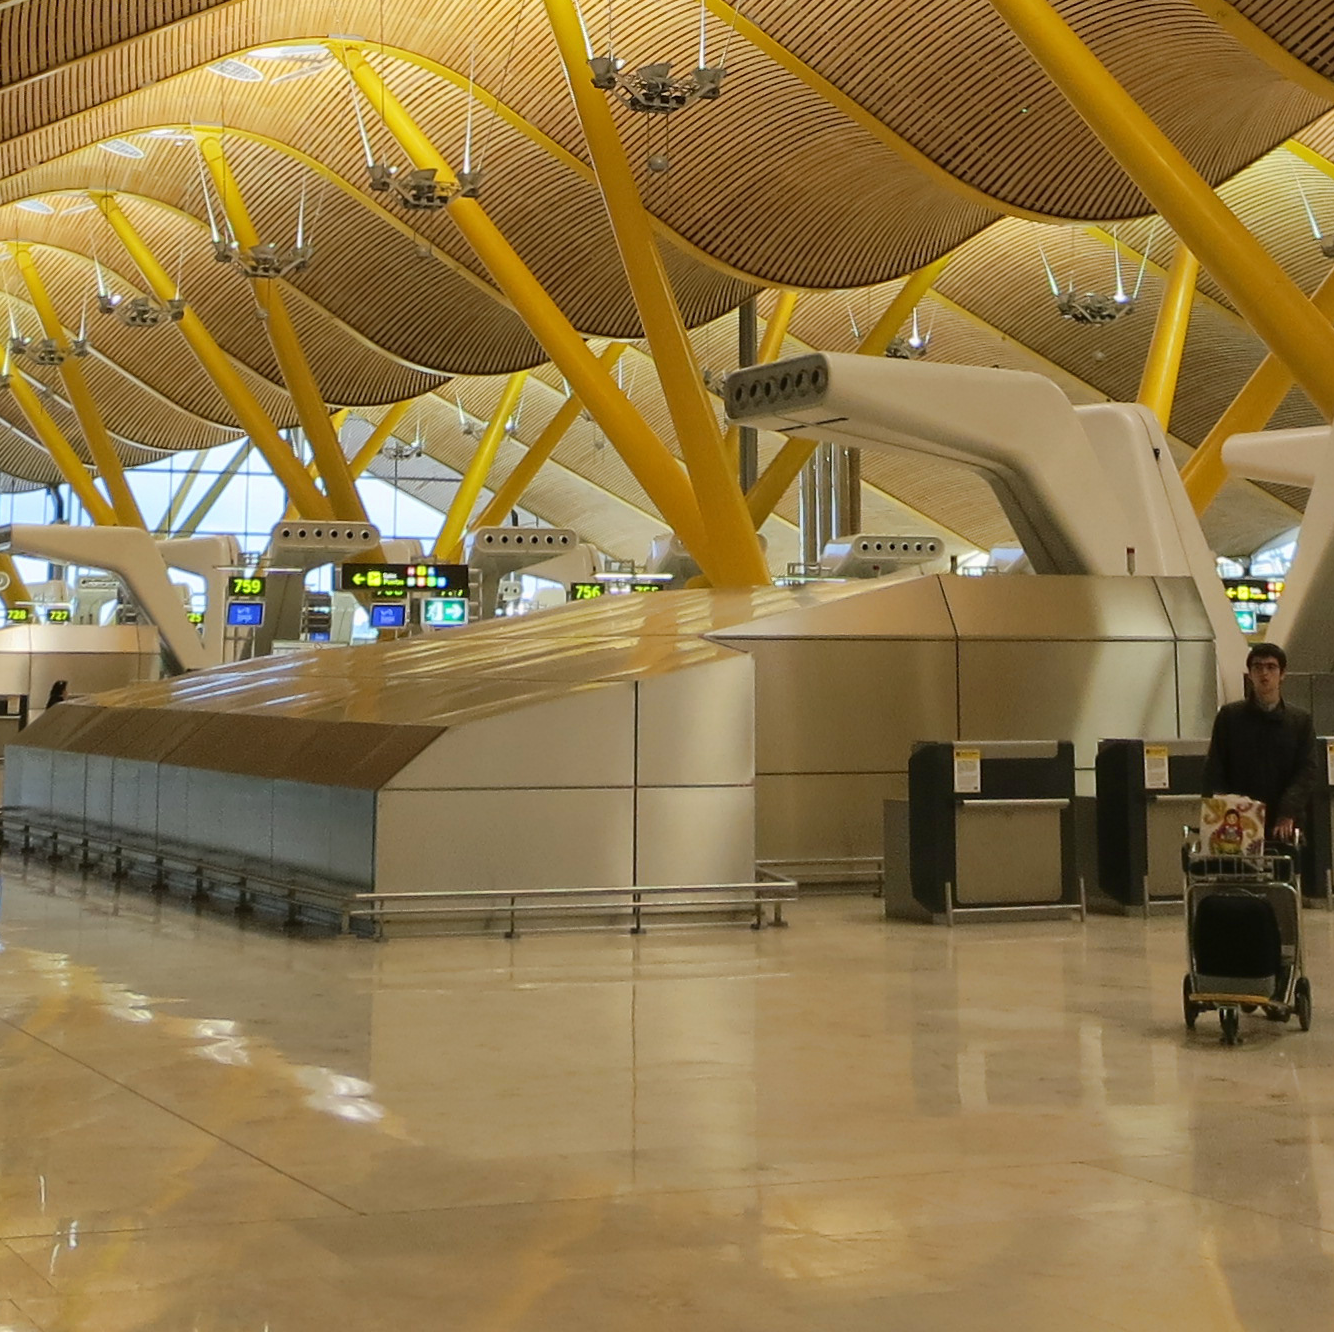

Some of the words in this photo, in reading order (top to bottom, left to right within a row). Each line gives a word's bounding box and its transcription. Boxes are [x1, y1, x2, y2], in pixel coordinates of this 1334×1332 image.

[234, 579, 261, 593] 759
[575, 585, 601, 599] 756
[7, 609, 27, 620] 728
[49, 610, 69, 621] 727
